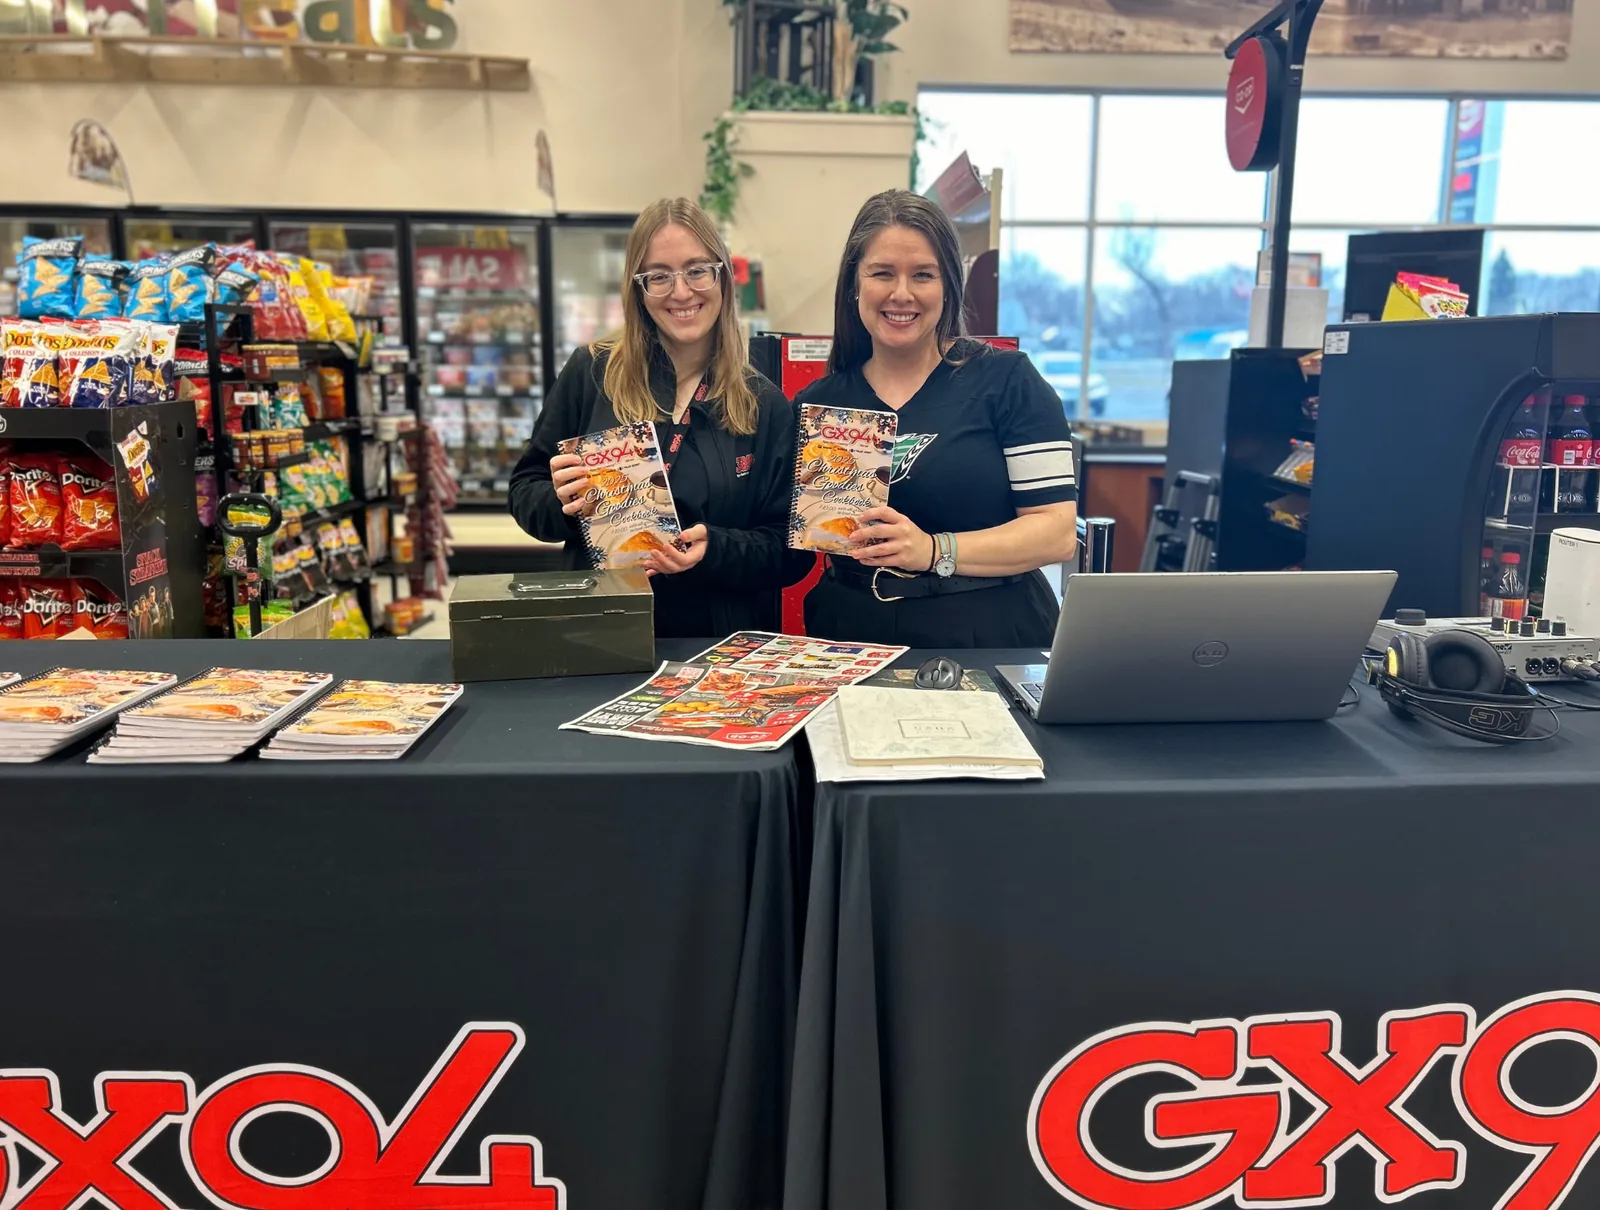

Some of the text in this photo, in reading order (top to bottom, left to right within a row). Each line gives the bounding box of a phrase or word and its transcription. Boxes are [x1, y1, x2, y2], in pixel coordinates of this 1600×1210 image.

[174, 359, 208, 371] CORNER
[820, 425, 871, 444] GX94
[585, 441, 634, 467] GX94
[807, 457, 877, 479] Christmas
[584, 477, 653, 504] Christmas
[601, 474, 628, 488] 2025
[812, 475, 865, 492] Goodies
[595, 495, 646, 517] Goodies
[822, 490, 872, 507] Cookbook
[610, 506, 659, 527] Cookbook
[1559, 538, 1575, 547] ROUTER
[227, 557, 248, 570] Spi
[1469, 705, 1531, 733] KG
[1027, 990, 1600, 1210] GX9
[0, 1022, 566, 1210] X94
